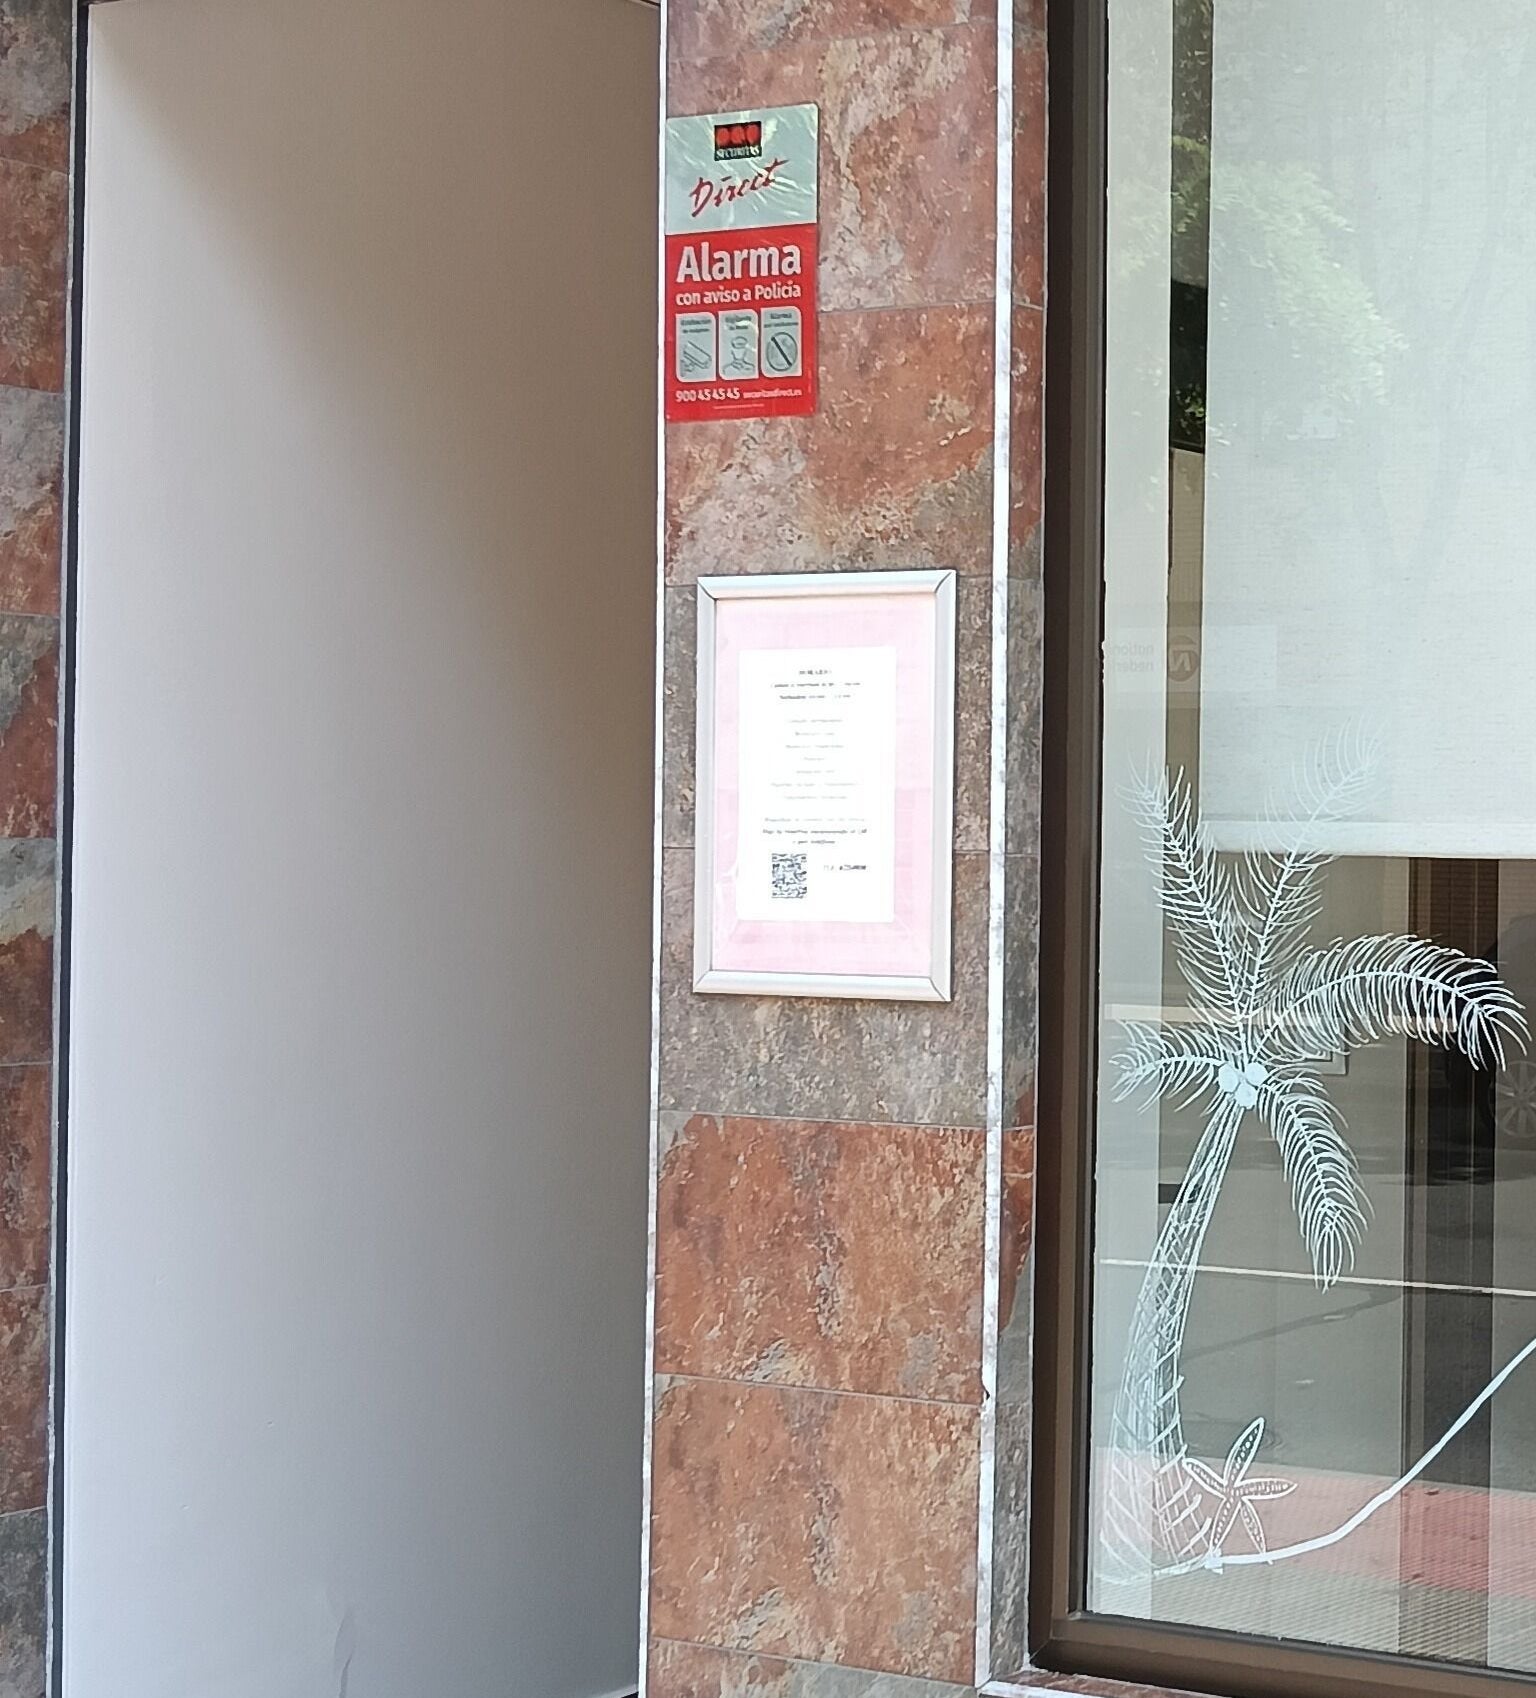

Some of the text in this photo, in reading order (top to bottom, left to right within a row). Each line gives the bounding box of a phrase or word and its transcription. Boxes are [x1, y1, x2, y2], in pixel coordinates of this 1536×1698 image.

[689, 158, 790, 217] Direct
[675, 241, 802, 284] Alarma
[675, 292, 701, 306] con
[703, 285, 741, 304] aviso
[742, 288, 752, 302] a
[675, 389, 697, 402] 900
[698, 388, 711, 401] 45
[712, 387, 726, 401] 45
[726, 386, 741, 400] 45
